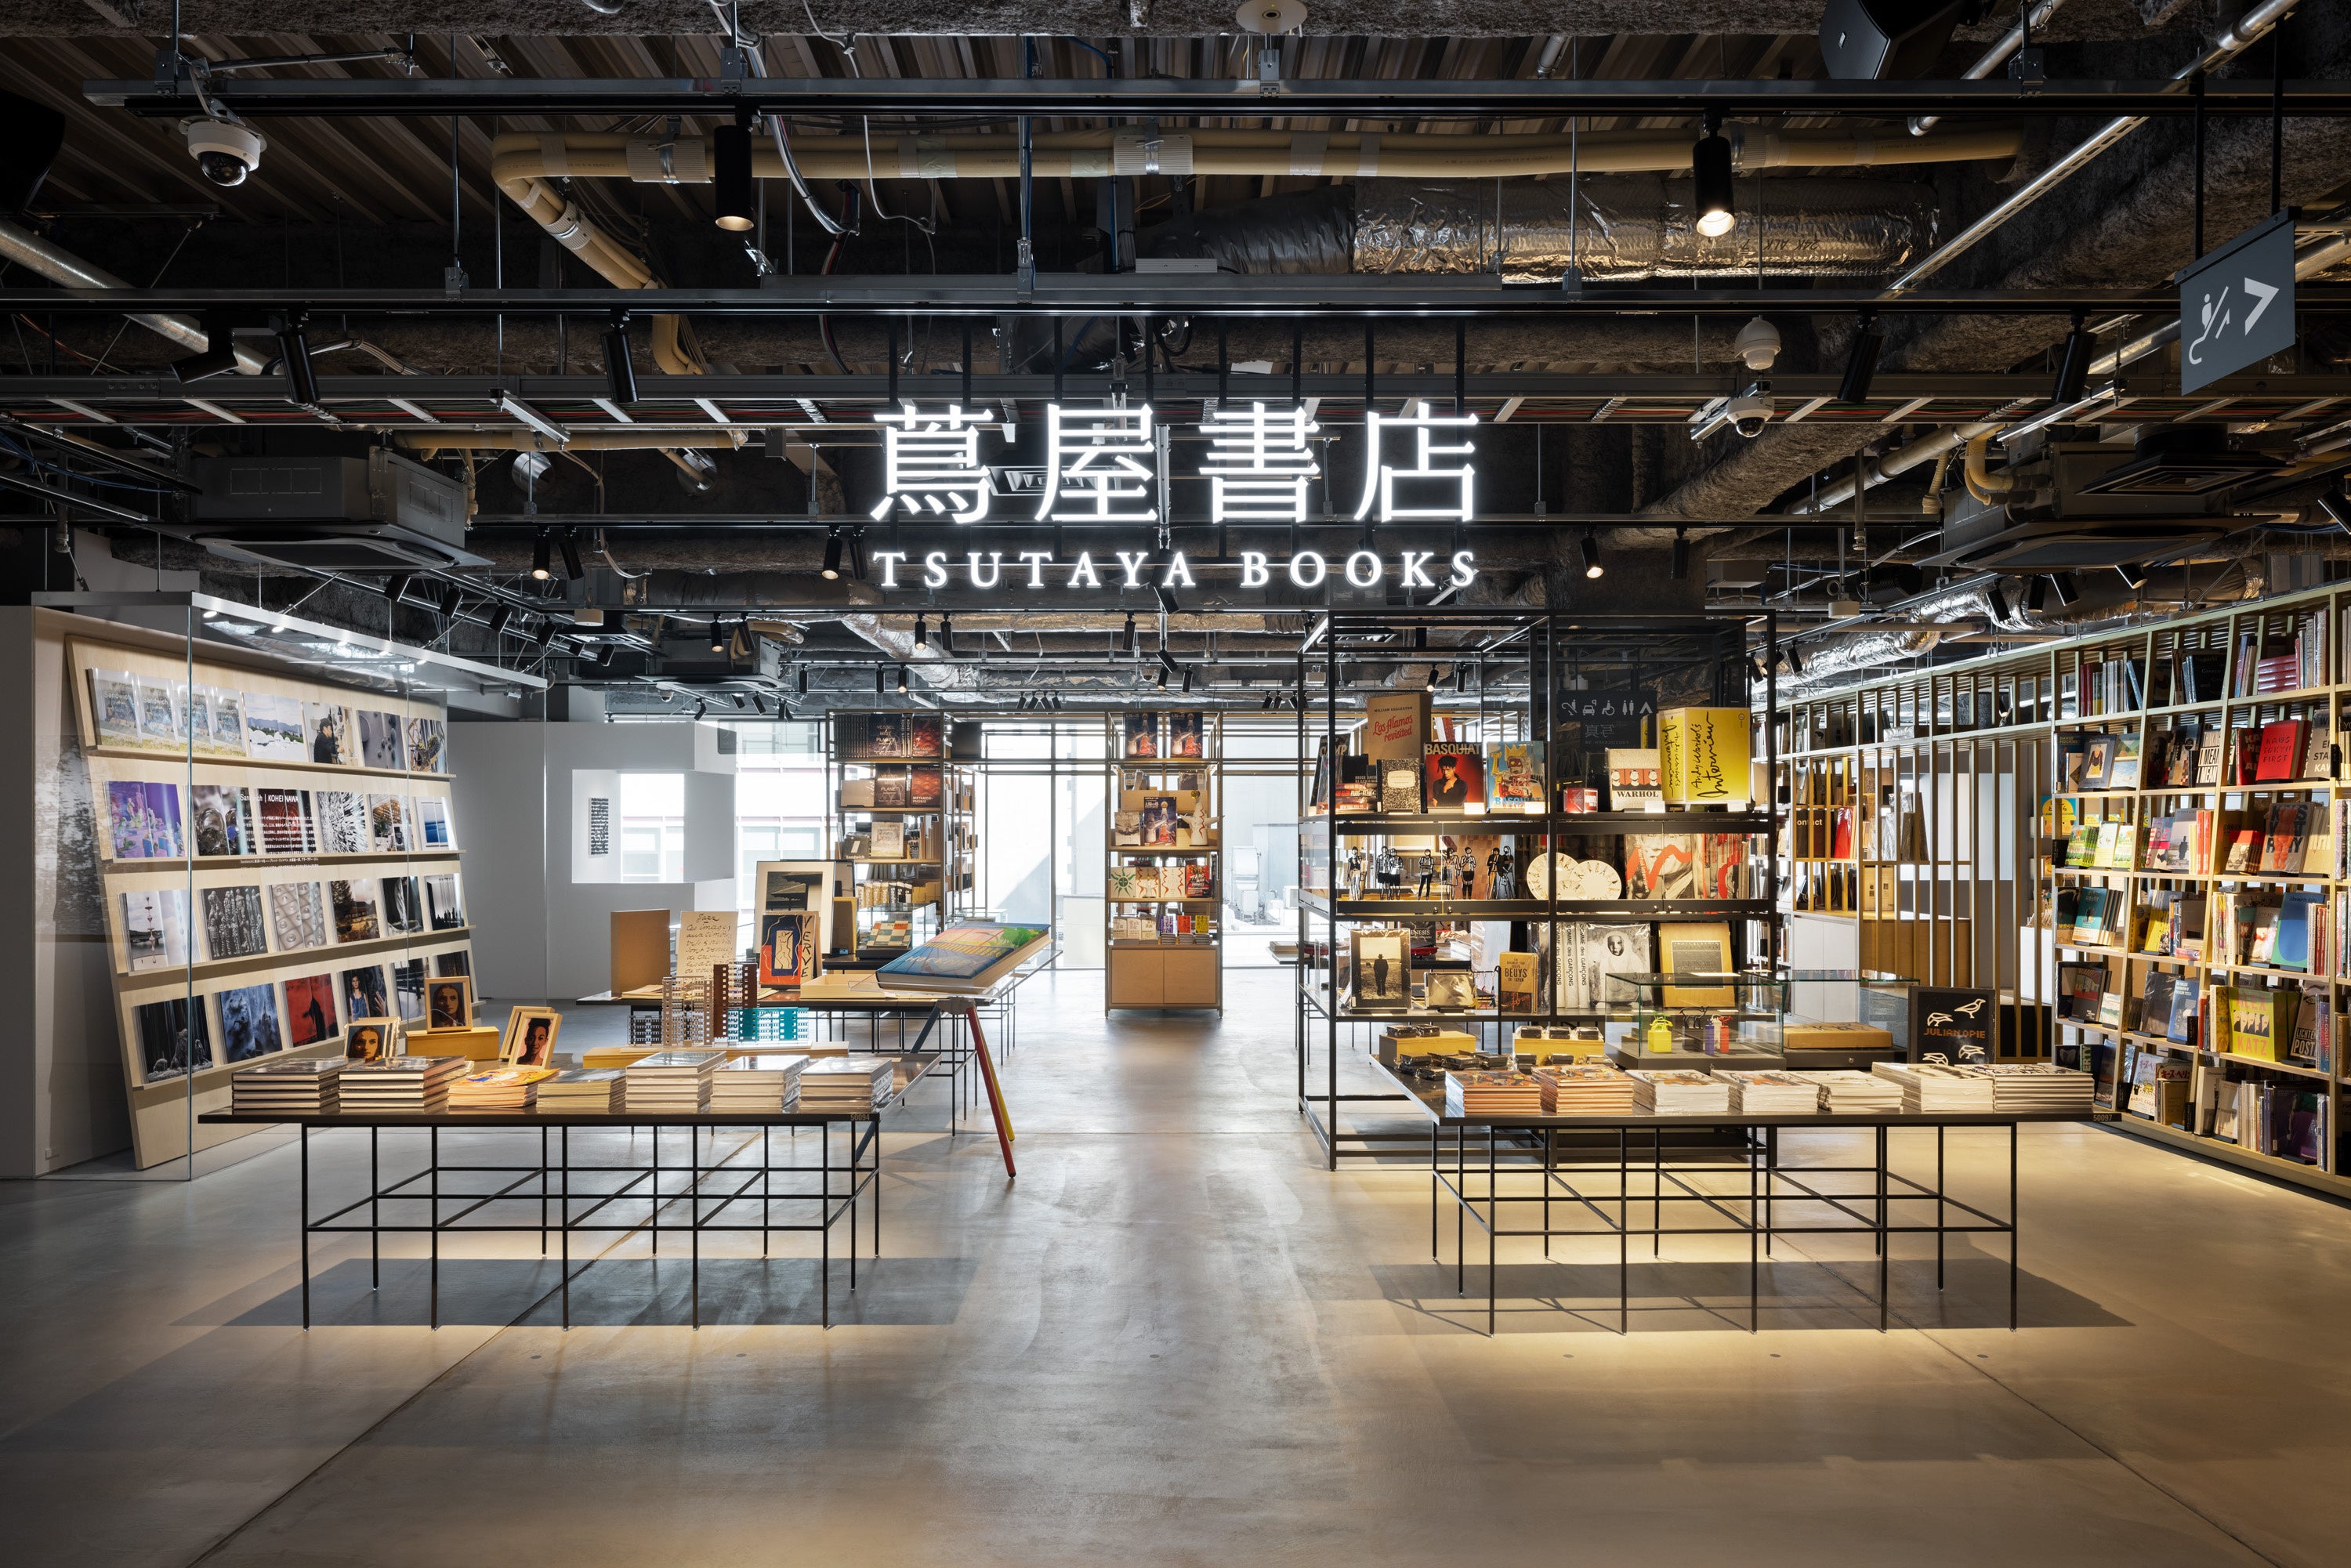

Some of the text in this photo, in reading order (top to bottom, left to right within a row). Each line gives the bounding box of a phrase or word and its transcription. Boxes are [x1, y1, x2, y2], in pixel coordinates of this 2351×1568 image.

[870, 402, 1479, 524] 蔦屋書店
[873, 551, 1476, 588] TSUTAYA BOOKS
[1373, 715, 1413, 736] Los Alamos
[1384, 725, 1413, 742] revisited
[2266, 736, 2290, 744] KAWS
[1319, 744, 1348, 757] CMP
[1425, 744, 1480, 755] BASQUIAT
[2263, 755, 2288, 763] FIRST
[2314, 764, 2331, 772] KAW
[801, 916, 812, 978] VERVE
[1505, 968, 1527, 978] BEUYS
[2236, 992, 2266, 1011] ALEX
[1924, 1028, 1985, 1039] JULIAN OPIE
[2296, 1028, 2316, 1040] LICHTEN
[2237, 1035, 2268, 1057] KATZ
[2293, 1039, 2316, 1056] POST
